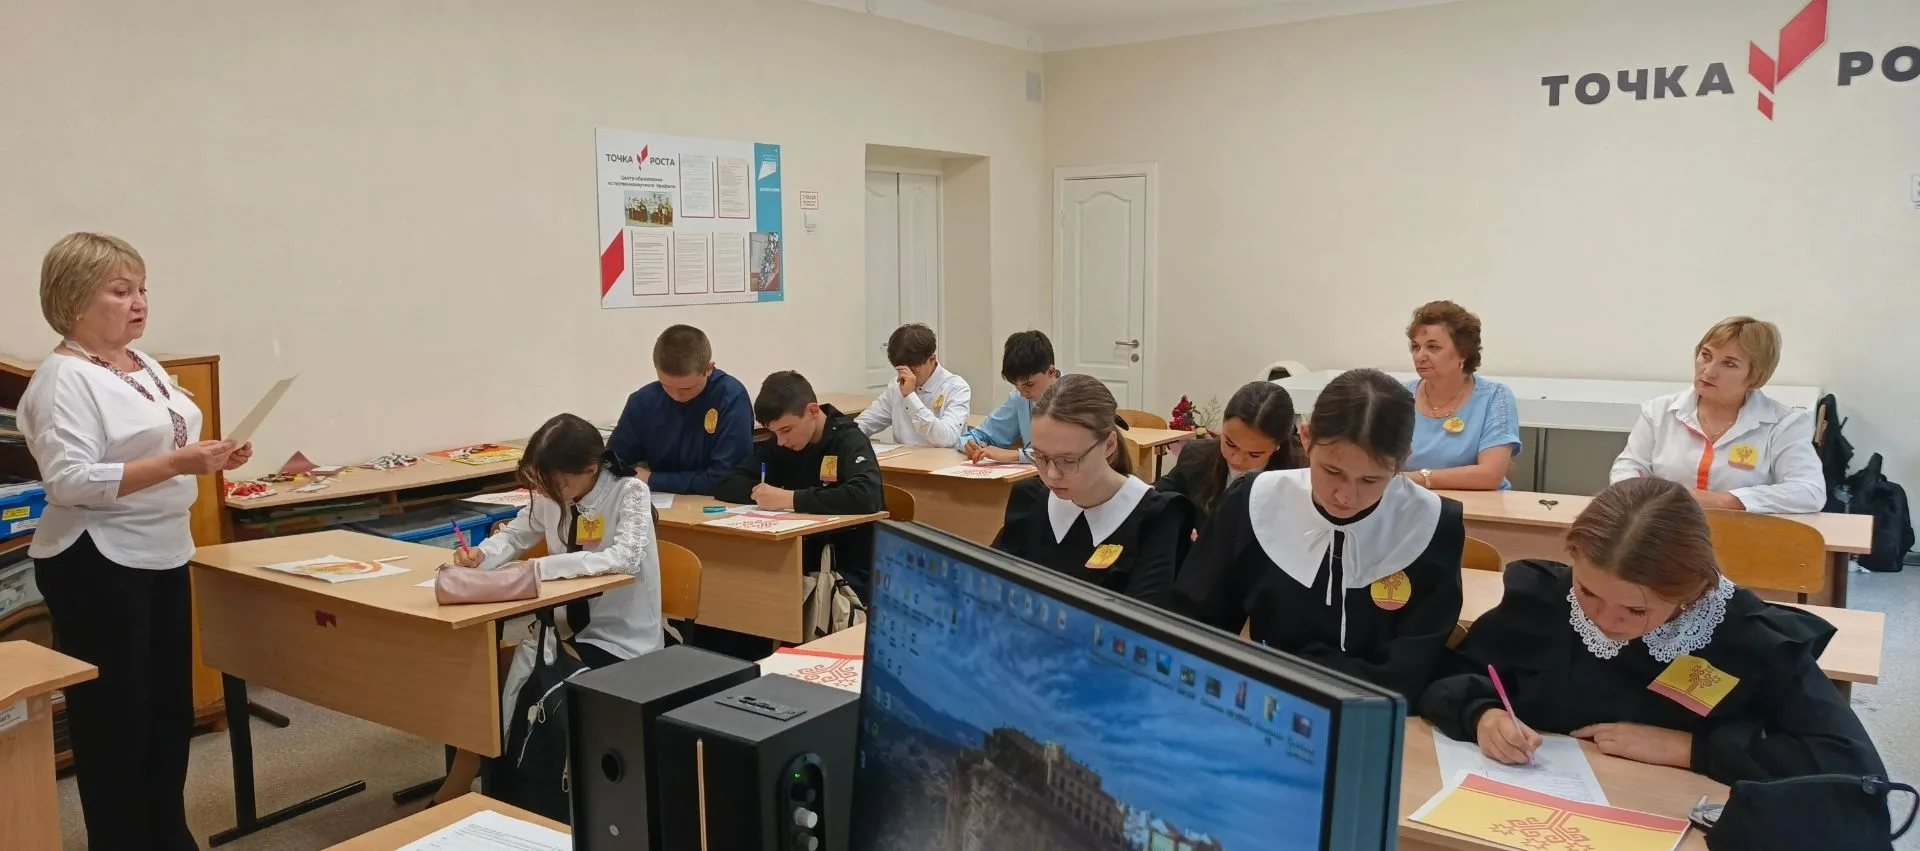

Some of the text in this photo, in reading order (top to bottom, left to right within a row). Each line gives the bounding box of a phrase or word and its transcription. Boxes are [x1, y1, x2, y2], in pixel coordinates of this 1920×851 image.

[1541, 62, 1735, 107] ТОЧКА
[605, 153, 675, 166] ТОЧКА РОСТА
